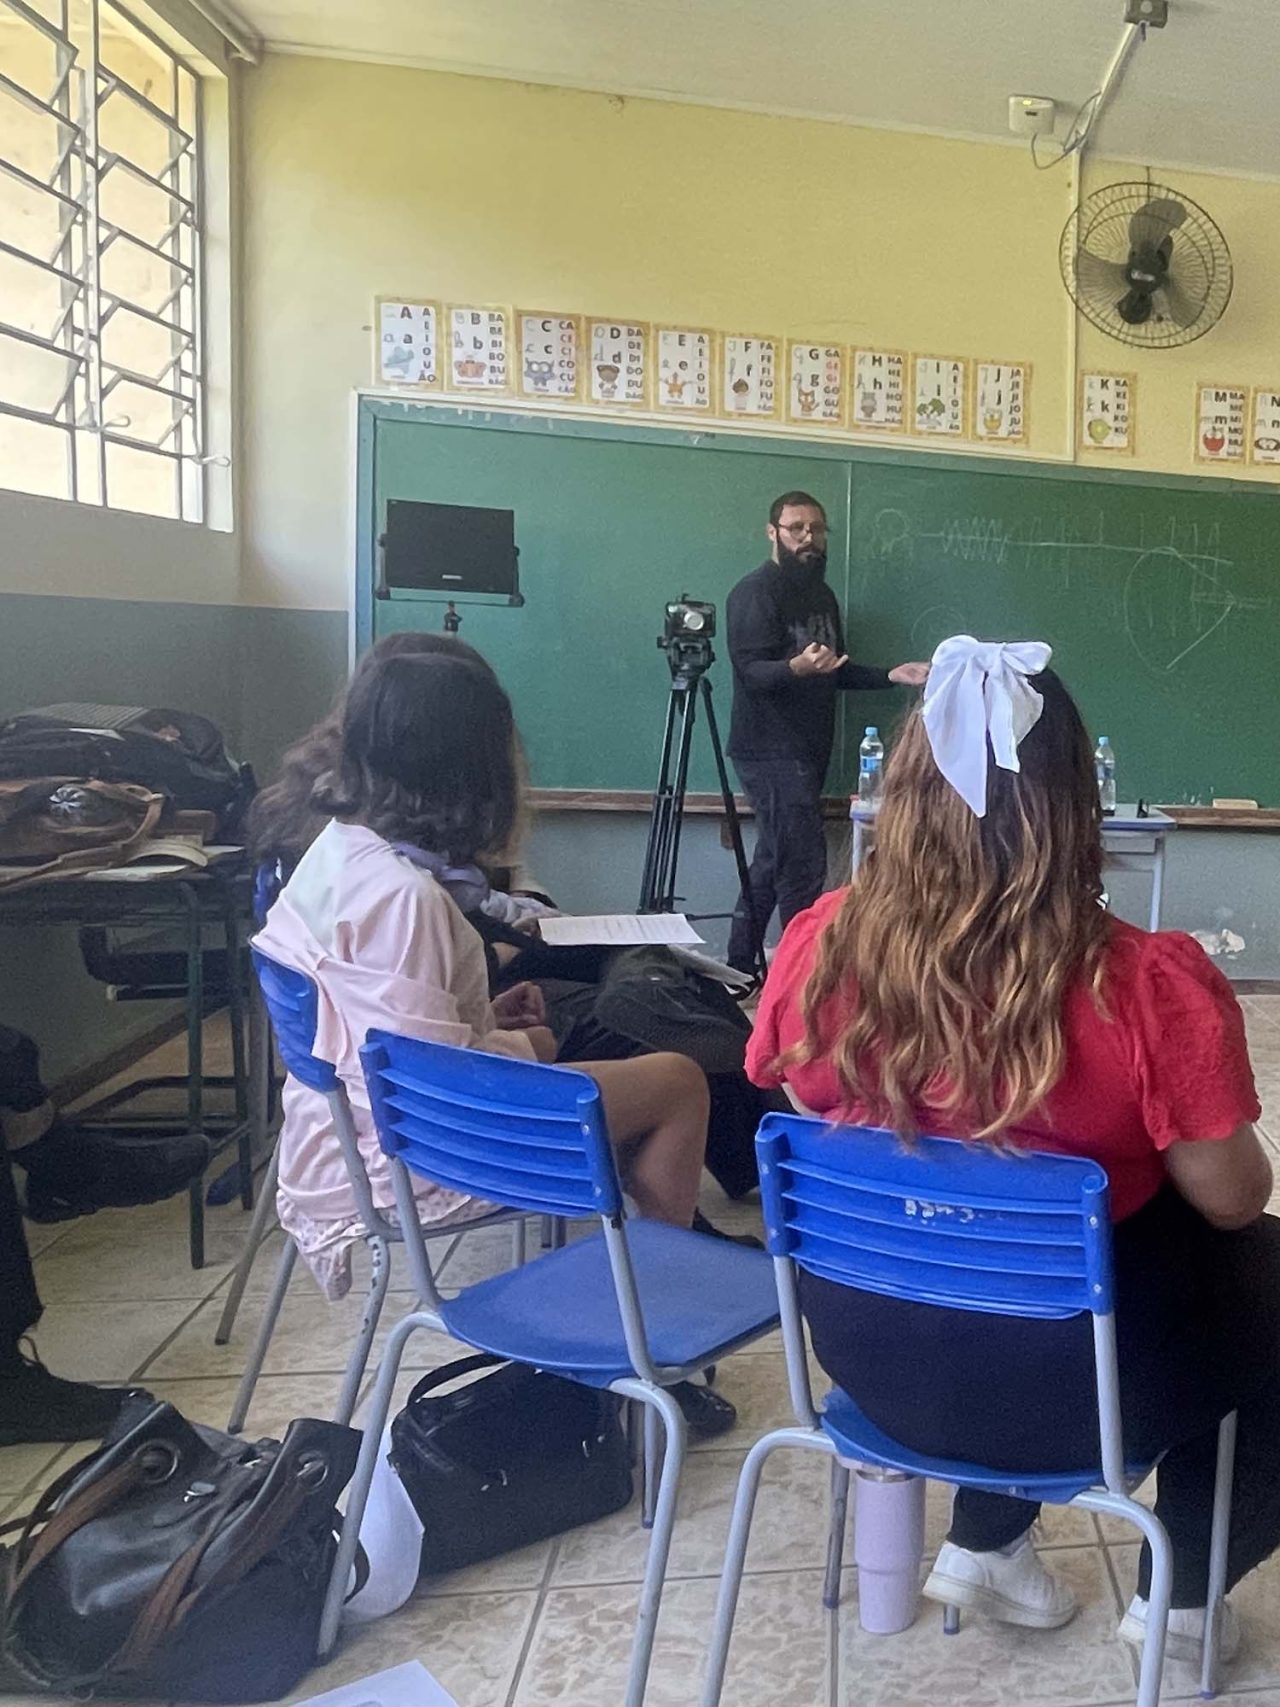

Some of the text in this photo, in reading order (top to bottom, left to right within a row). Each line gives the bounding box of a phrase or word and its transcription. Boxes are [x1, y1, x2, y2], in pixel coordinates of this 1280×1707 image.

[401, 306, 412, 319] A
[471, 312, 481, 325] B
[541, 320, 552, 332] C
[559, 321, 574, 331] CA
[610, 327, 621, 339] D
[628, 328, 642, 337] DA
[403, 334, 413, 344] a
[473, 336, 483, 350] b
[678, 335, 686, 347] E
[697, 335, 705, 344] A
[544, 345, 552, 354] c
[744, 341, 752, 353] F
[489, 353, 505, 362] BO
[612, 352, 621, 364] d
[809, 348, 819, 360] G
[825, 349, 839, 358] GA
[559, 360, 575, 369] CO
[679, 360, 688, 370] e
[872, 355, 882, 367] H
[490, 366, 505, 375] BU
[626, 366, 643, 375] DO
[560, 373, 575, 382] CU
[697, 373, 705, 382] O
[810, 374, 819, 387] g
[628, 379, 642, 389] DU
[873, 378, 882, 390] h
[1100, 379, 1109, 391] K
[1214, 391, 1227, 403] M
[1271, 396, 1280, 408] N
[1101, 400, 1109, 413] k
[1214, 415, 1227, 425] m
[1271, 420, 1280, 429] n
